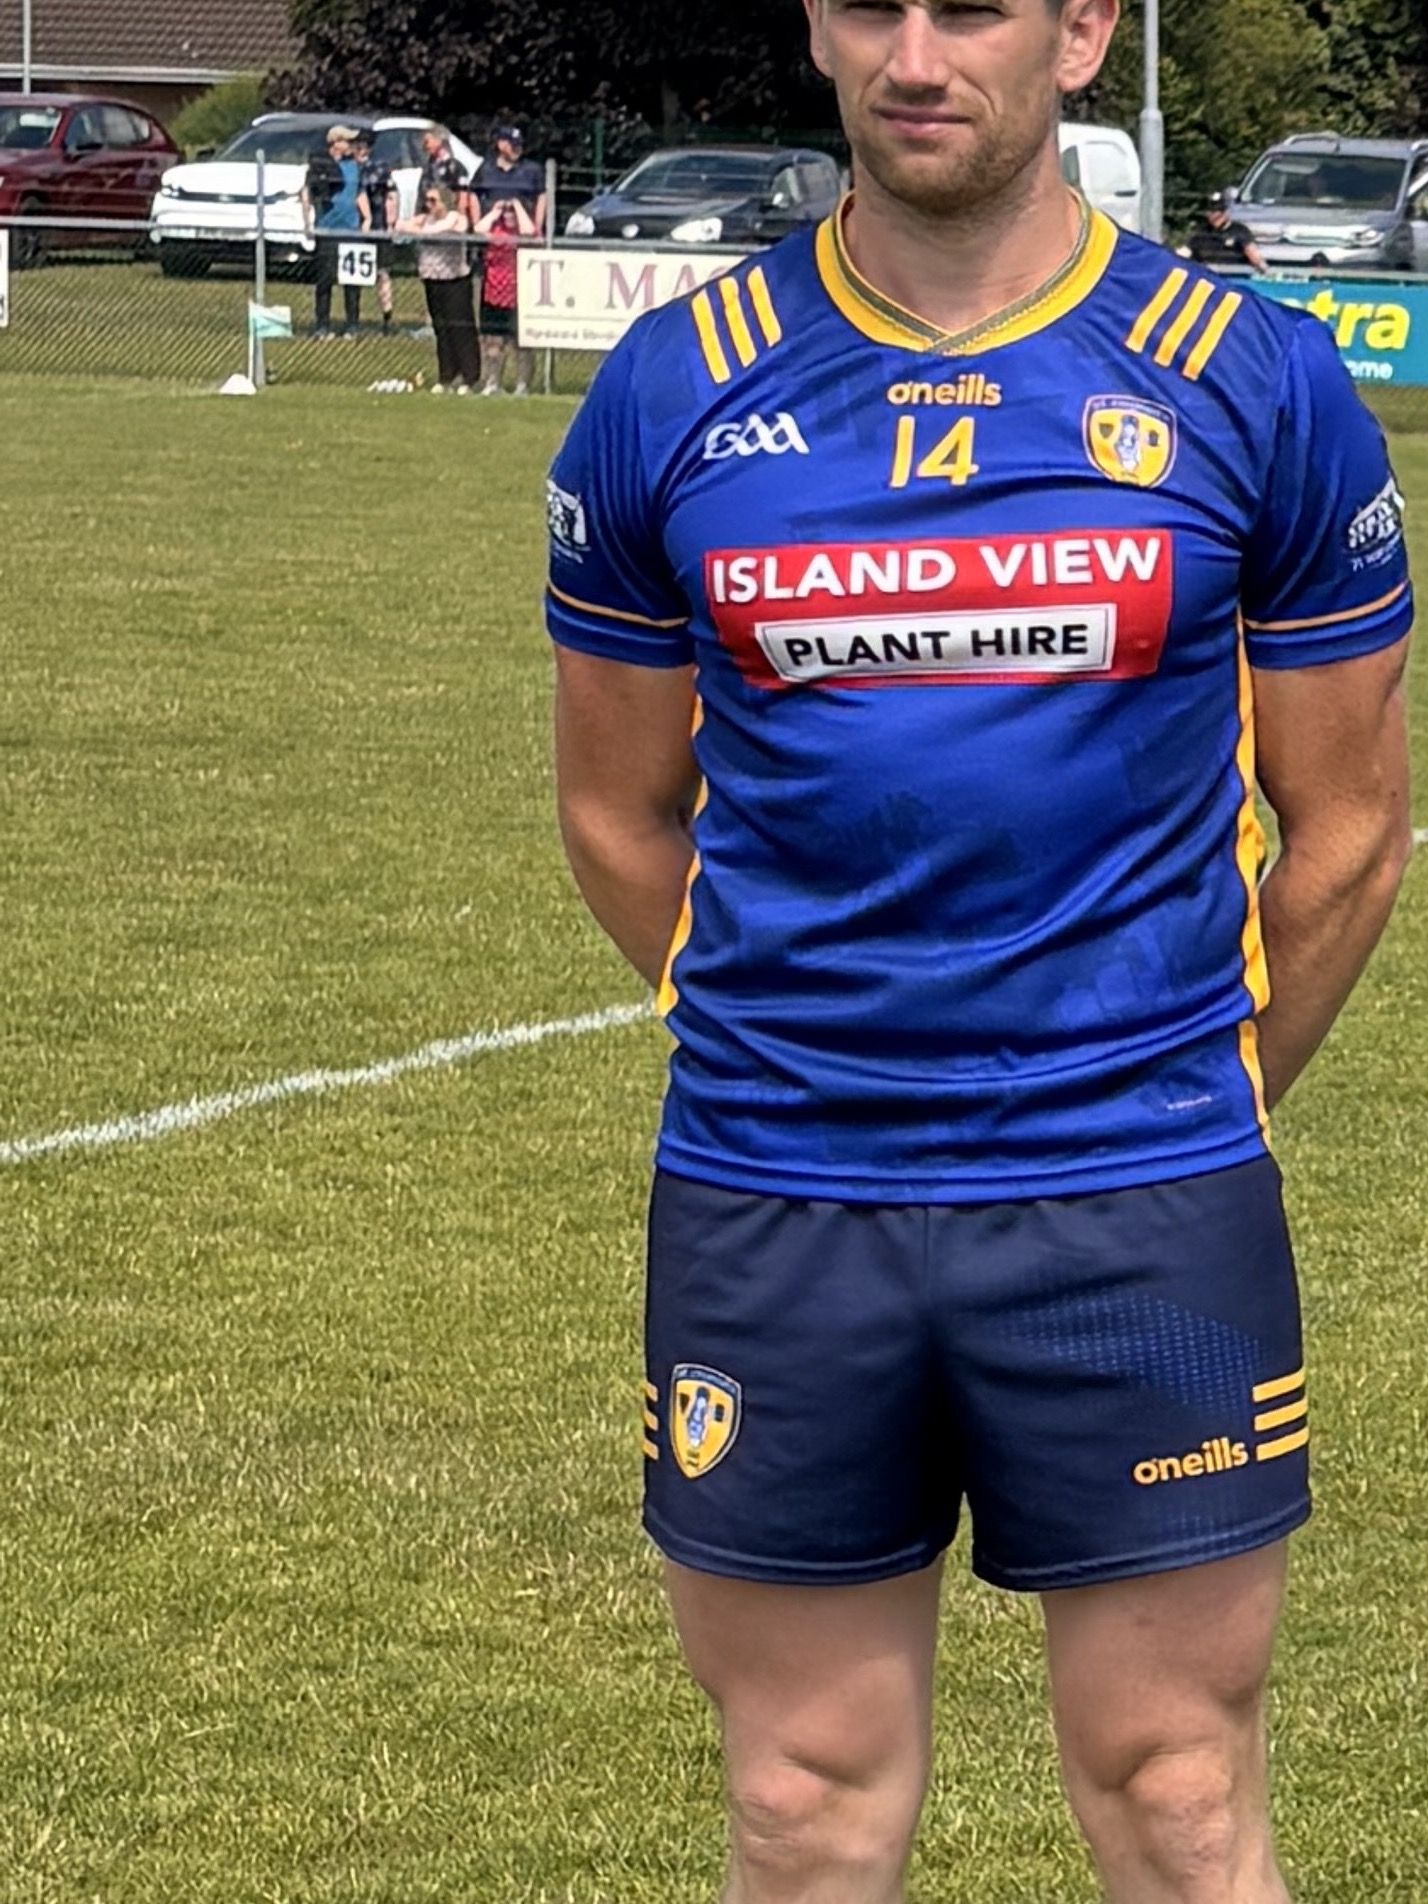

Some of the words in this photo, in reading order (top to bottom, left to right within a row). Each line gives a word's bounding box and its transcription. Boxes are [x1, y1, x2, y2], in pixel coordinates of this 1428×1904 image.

[343, 250, 373, 278] 45
[527, 259, 576, 309] T.
[1283, 289, 1410, 349] tra
[889, 415, 979, 487] 14
[713, 549, 957, 603] ISLAND
[982, 537, 1160, 587] VIEW
[785, 631, 950, 667] PLANT
[971, 624, 1088, 657] HIRE
